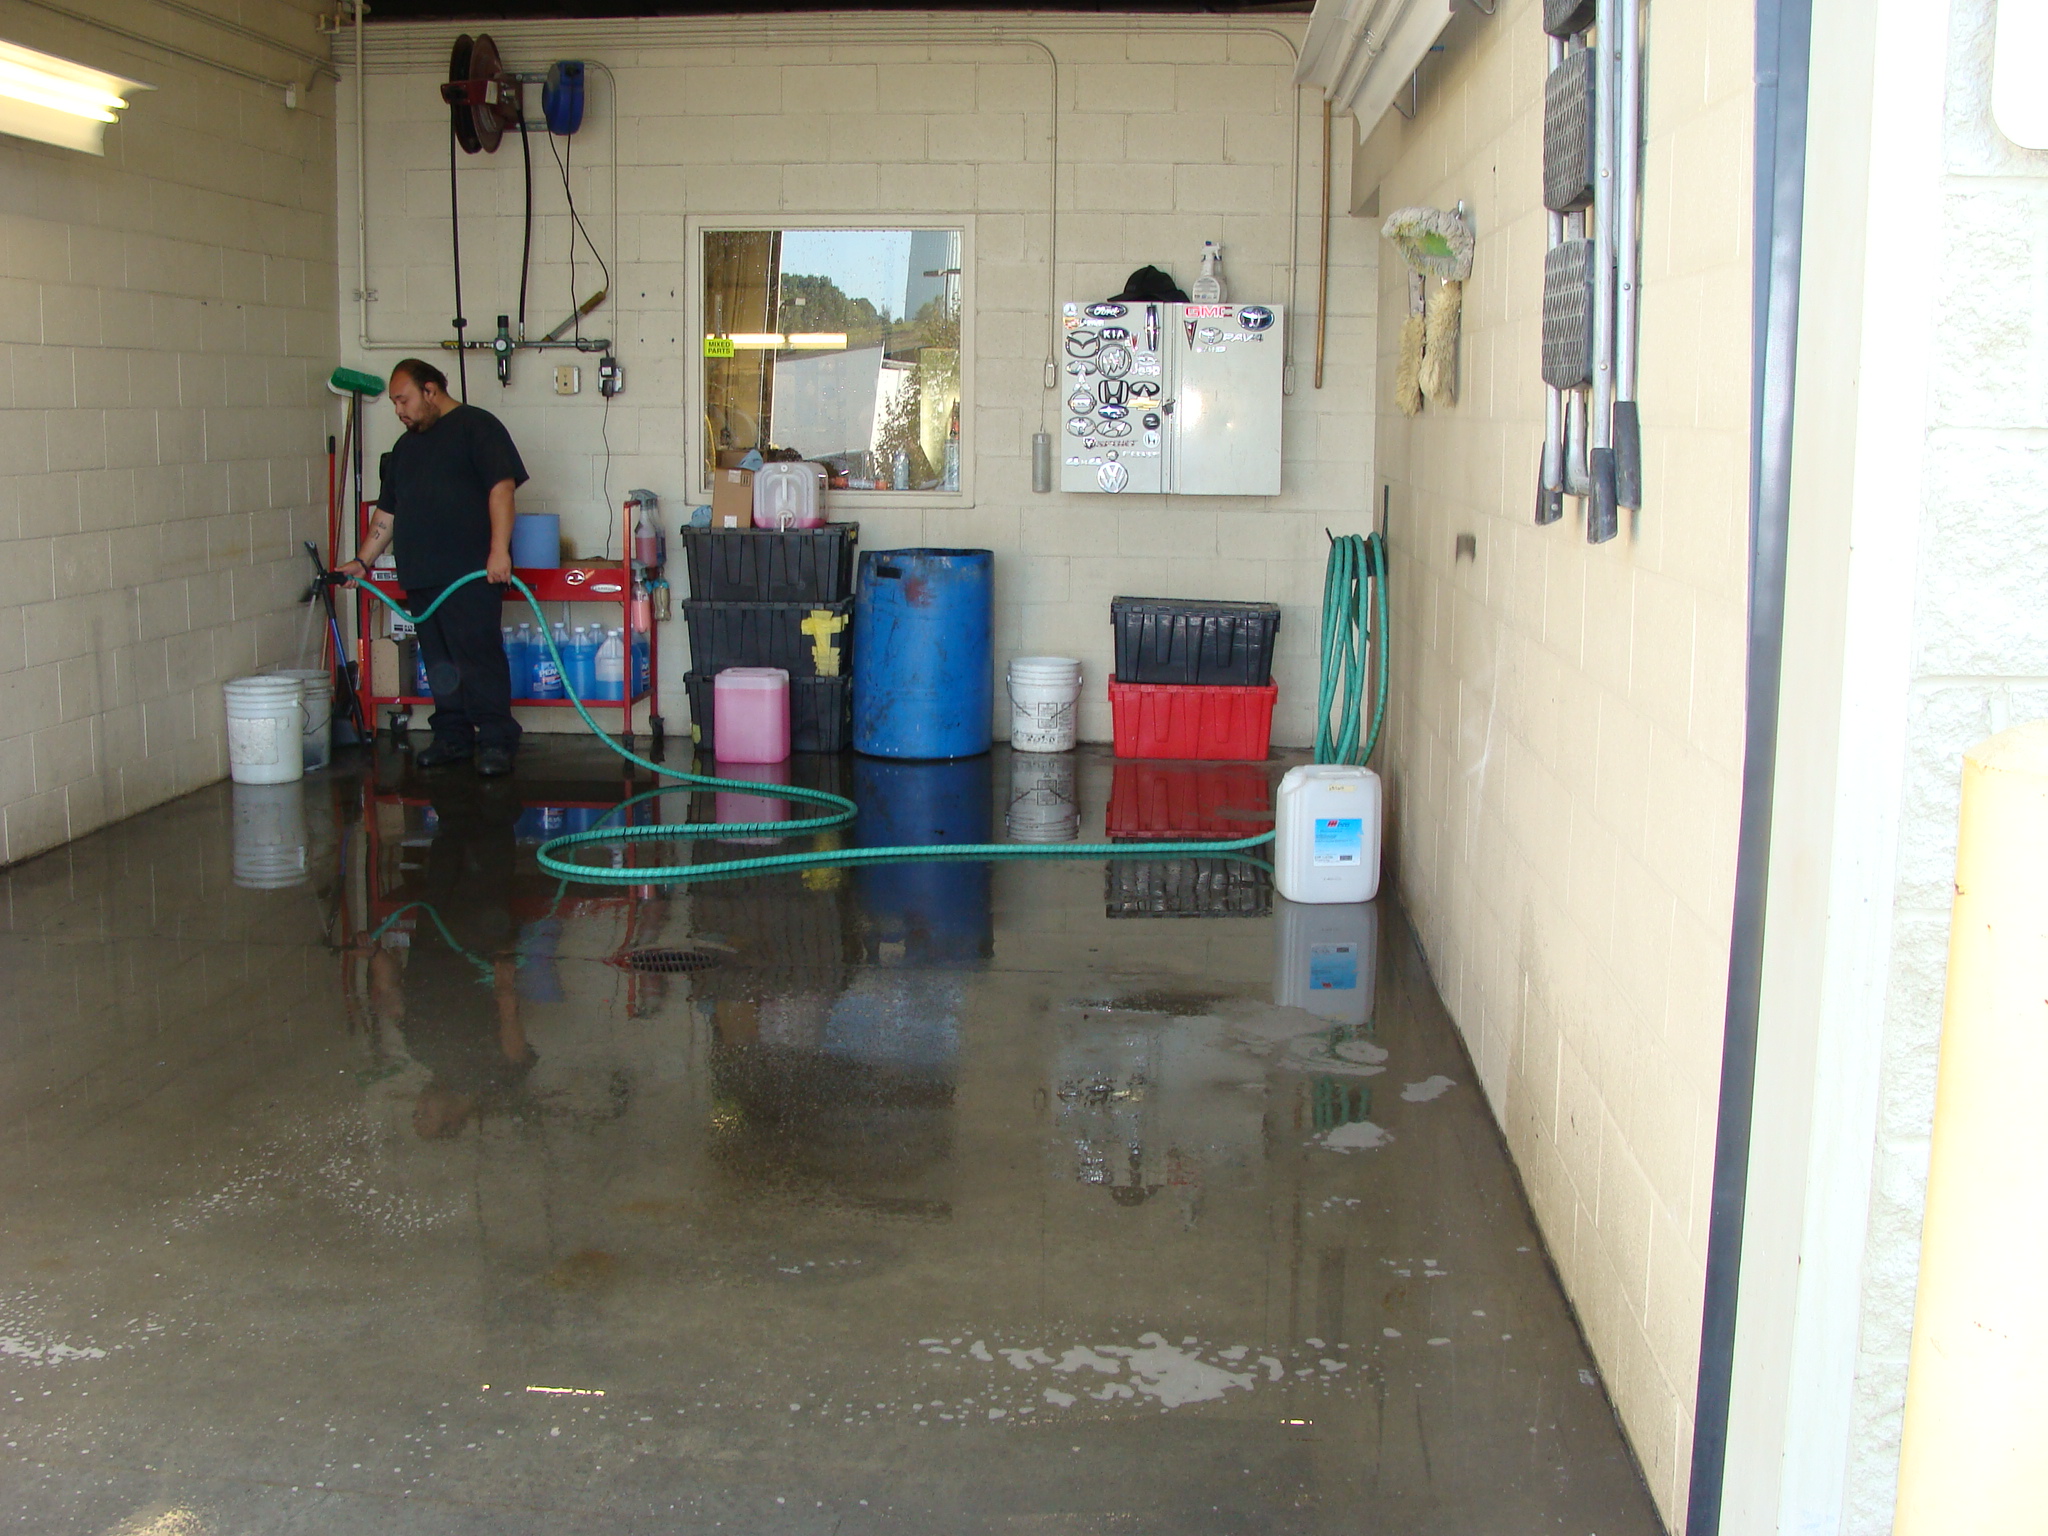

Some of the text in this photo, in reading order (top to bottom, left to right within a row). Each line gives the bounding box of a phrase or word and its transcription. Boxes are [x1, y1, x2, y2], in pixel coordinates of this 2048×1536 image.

[1184, 306, 1233, 318] GMC
[1103, 329, 1125, 339] KIA
[1130, 362, 1161, 378] Jeep
